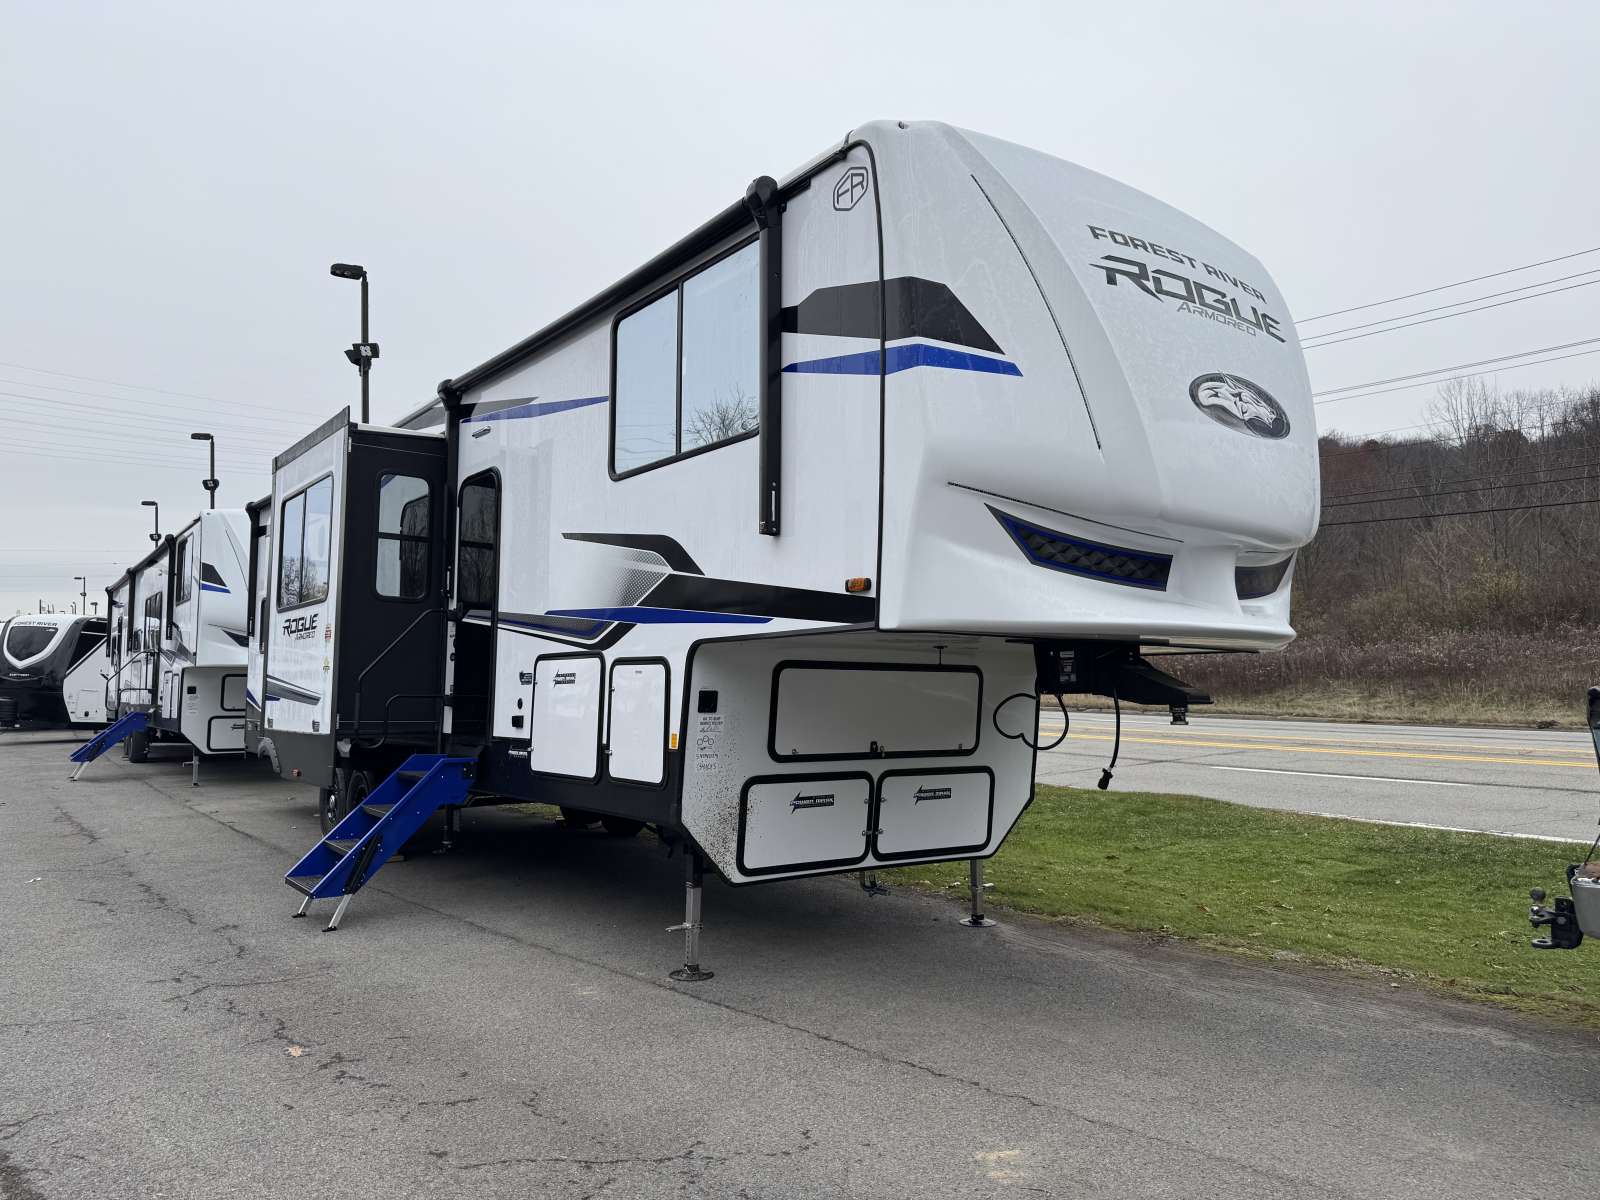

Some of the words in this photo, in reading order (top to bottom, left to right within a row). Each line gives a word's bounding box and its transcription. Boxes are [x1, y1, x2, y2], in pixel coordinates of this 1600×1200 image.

[1087, 225, 1197, 269] FOREST
[1201, 261, 1268, 305] RIVER
[1088, 254, 1288, 343] ROGUE
[1176, 301, 1257, 337] ARMORED
[282, 613, 319, 637] ROGUE
